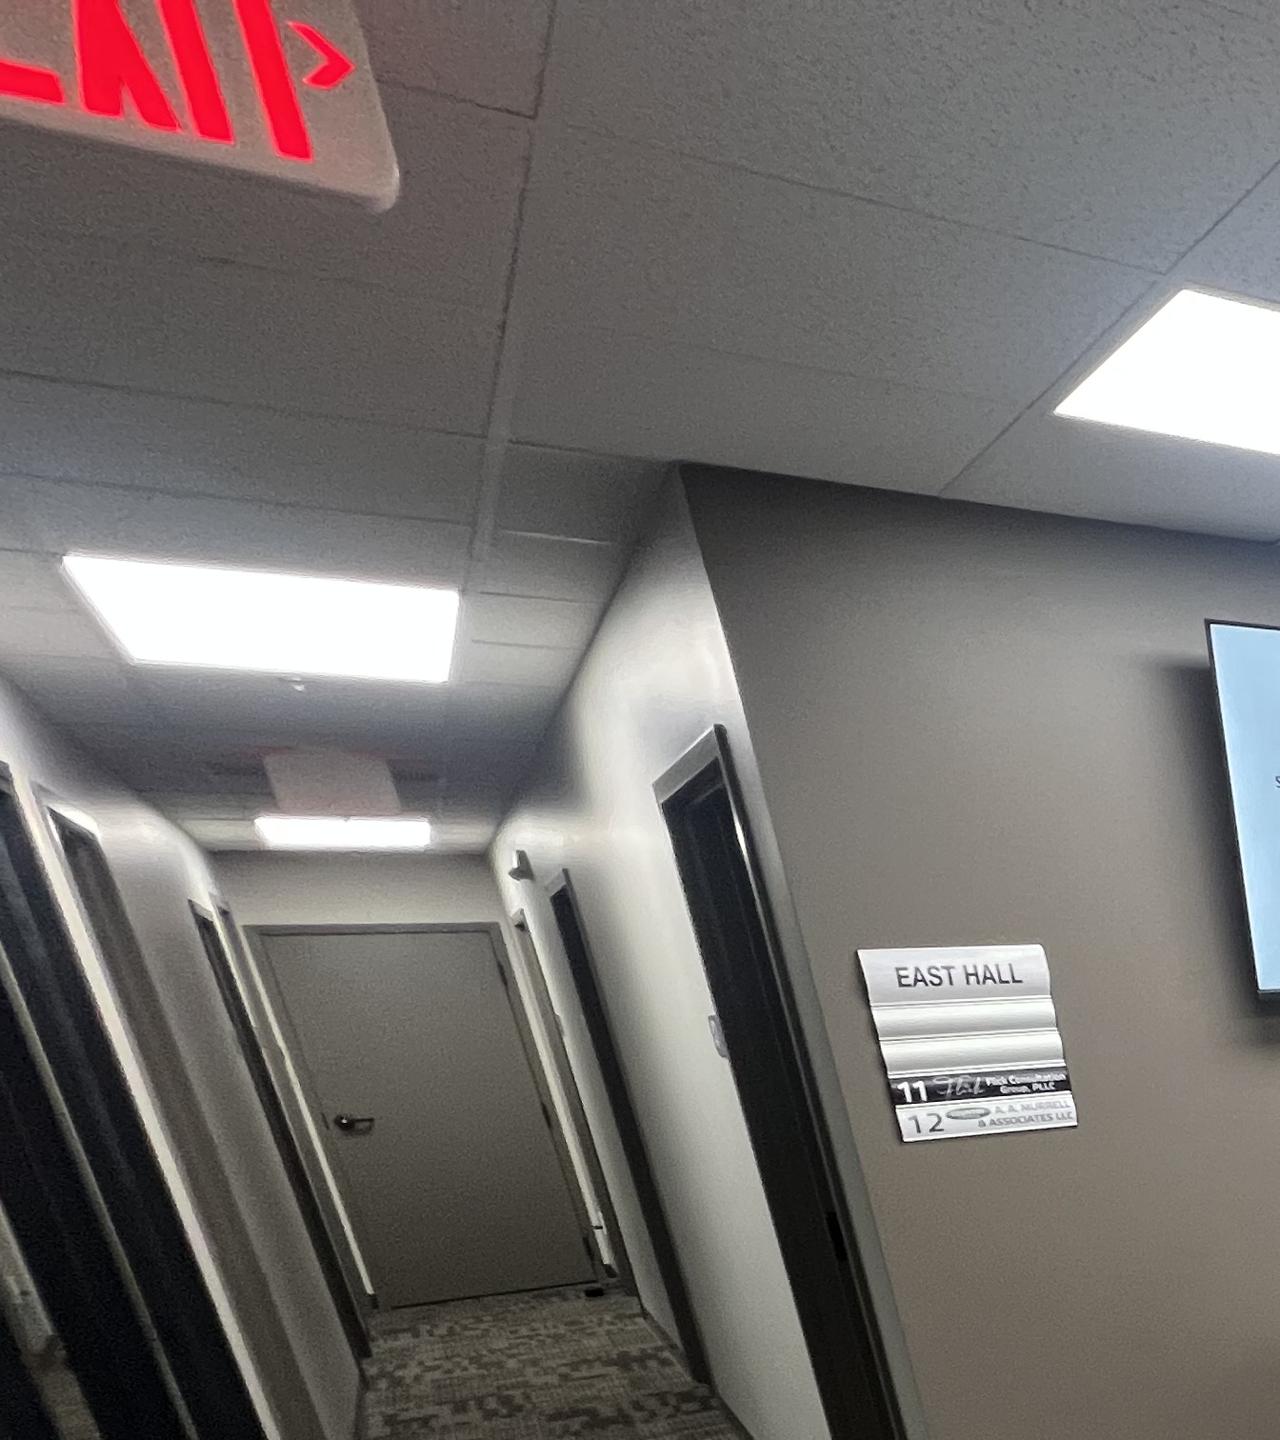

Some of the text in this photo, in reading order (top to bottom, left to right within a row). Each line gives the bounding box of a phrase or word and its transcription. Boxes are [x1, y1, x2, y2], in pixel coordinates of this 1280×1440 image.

[894, 963, 1024, 988] EAST HALL
[897, 1080, 927, 1103] 11
[1031, 1081, 1056, 1092] PLLC
[908, 1113, 945, 1134] 12
[988, 1113, 1054, 1127] ASSOCIATES
[1055, 1111, 1073, 1121] LLC
